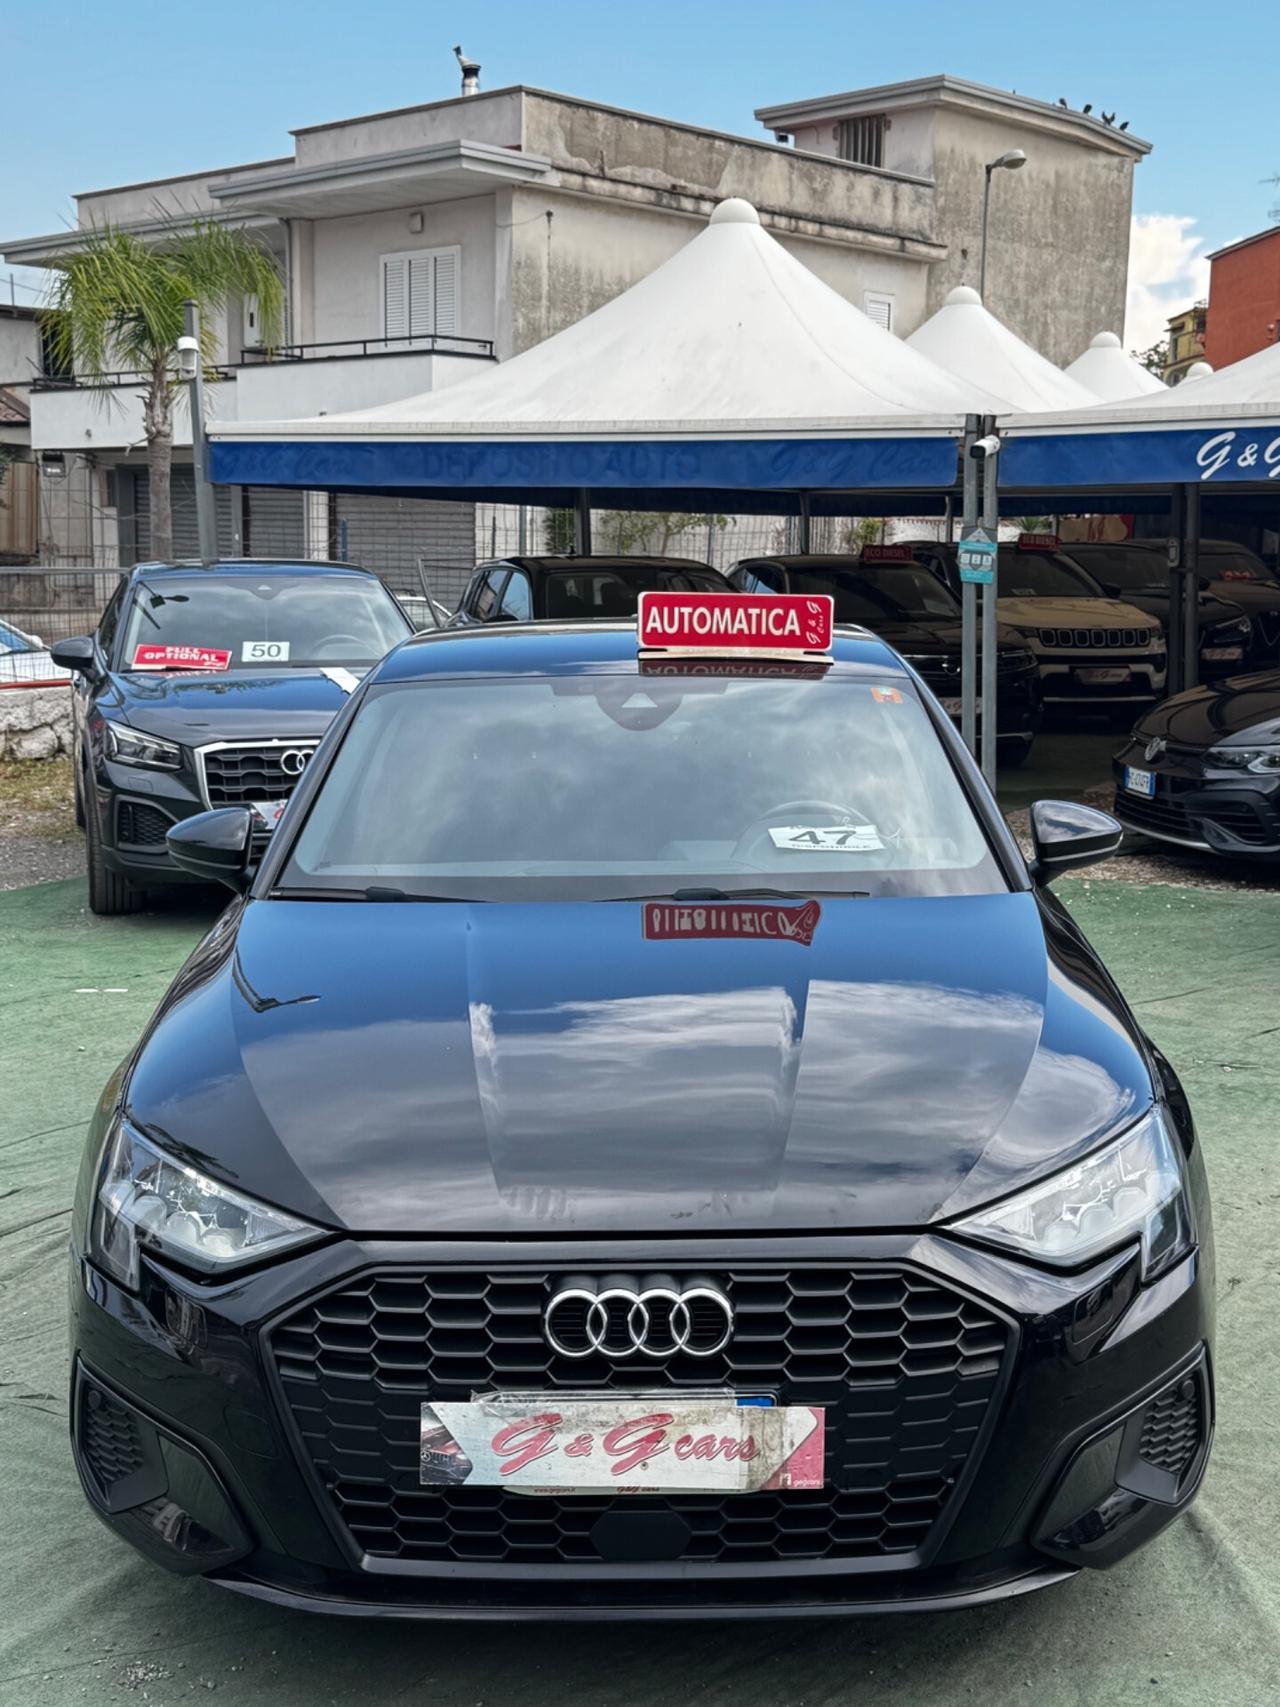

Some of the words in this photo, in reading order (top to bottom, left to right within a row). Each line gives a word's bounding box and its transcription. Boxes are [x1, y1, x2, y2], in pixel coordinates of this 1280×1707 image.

[1196, 431, 1236, 480] G
[1237, 443, 1259, 467] &
[645, 606, 801, 636] AUTOMATICA
[143, 651, 219, 662] OPTIONAL
[165, 646, 200, 655] FULL
[250, 643, 282, 659] 50
[788, 830, 857, 845] 47
[490, 1412, 562, 1477] G
[564, 1432, 594, 1458] &
[602, 1413, 674, 1477] G
[674, 1430, 763, 1463] cars
